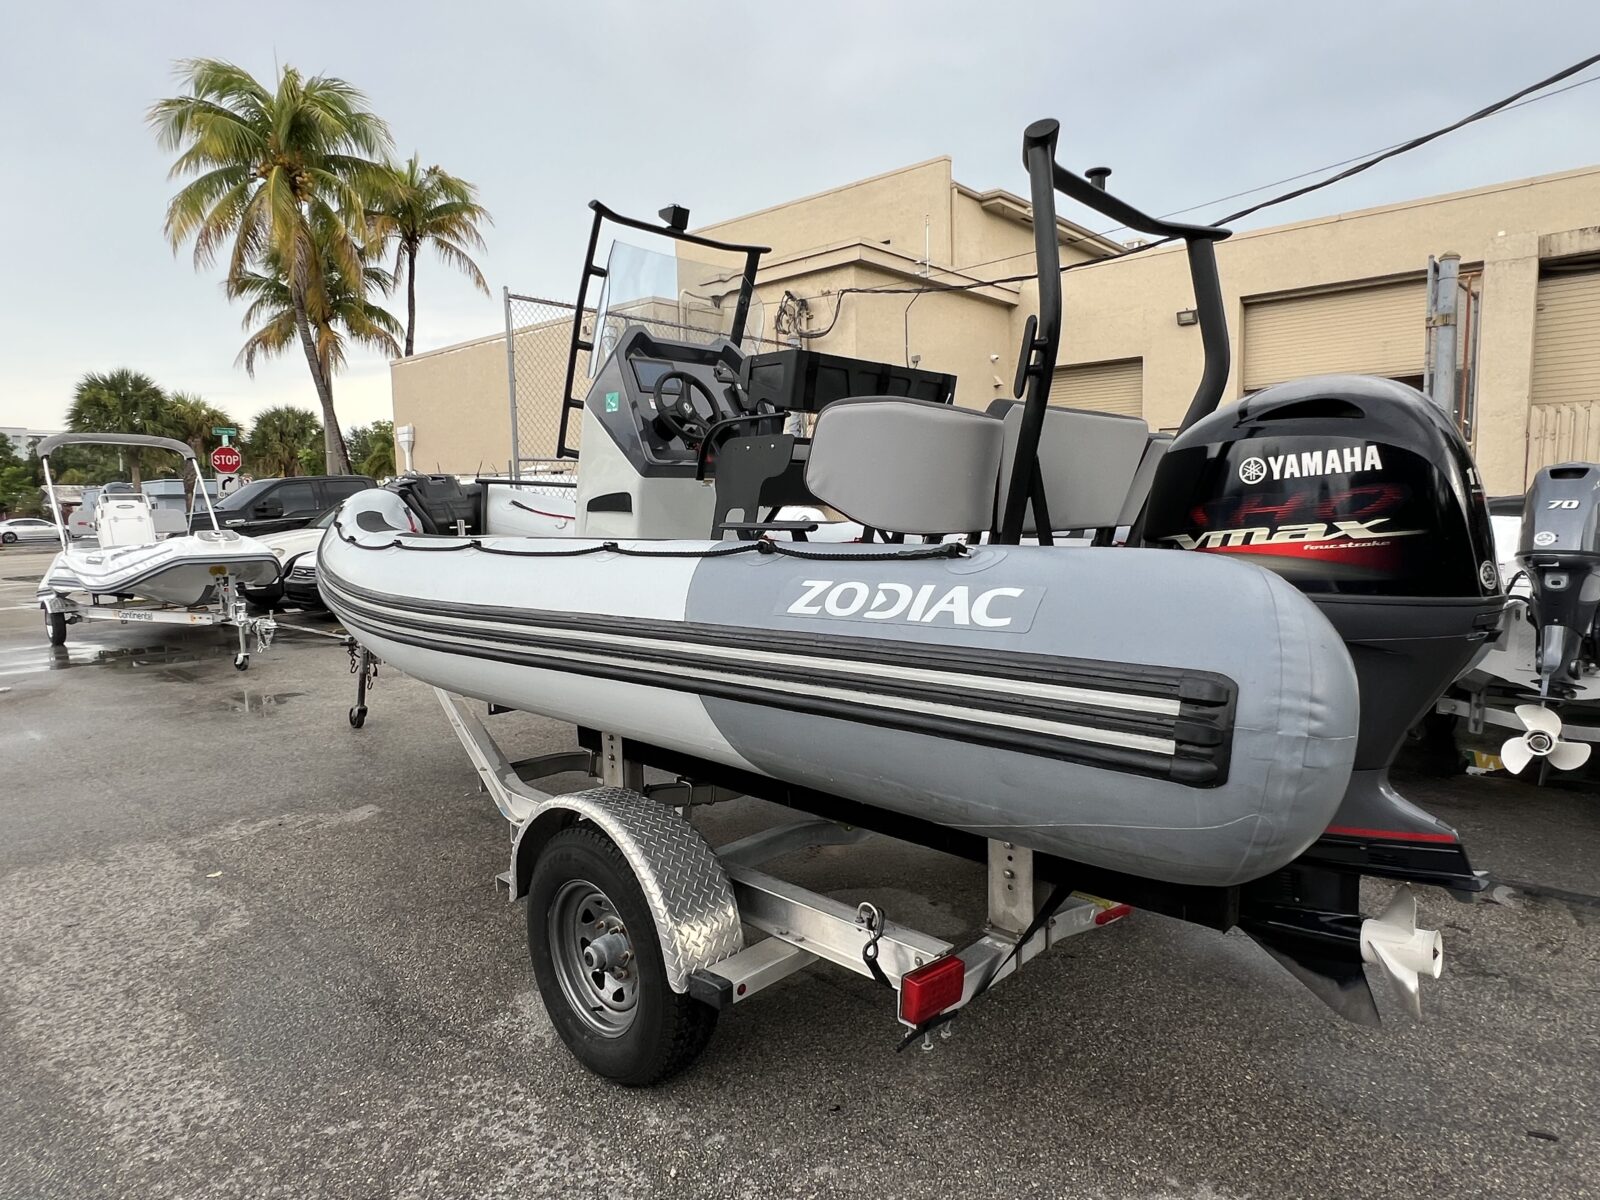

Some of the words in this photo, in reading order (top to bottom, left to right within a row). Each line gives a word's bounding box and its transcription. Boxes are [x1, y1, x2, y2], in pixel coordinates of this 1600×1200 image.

[213, 455, 239, 465] STOP
[1268, 445, 1383, 480] YAMAHA
[1548, 500, 1580, 509] 70
[786, 579, 1025, 627] ZODIAC
[117, 611, 153, 620] Continental
